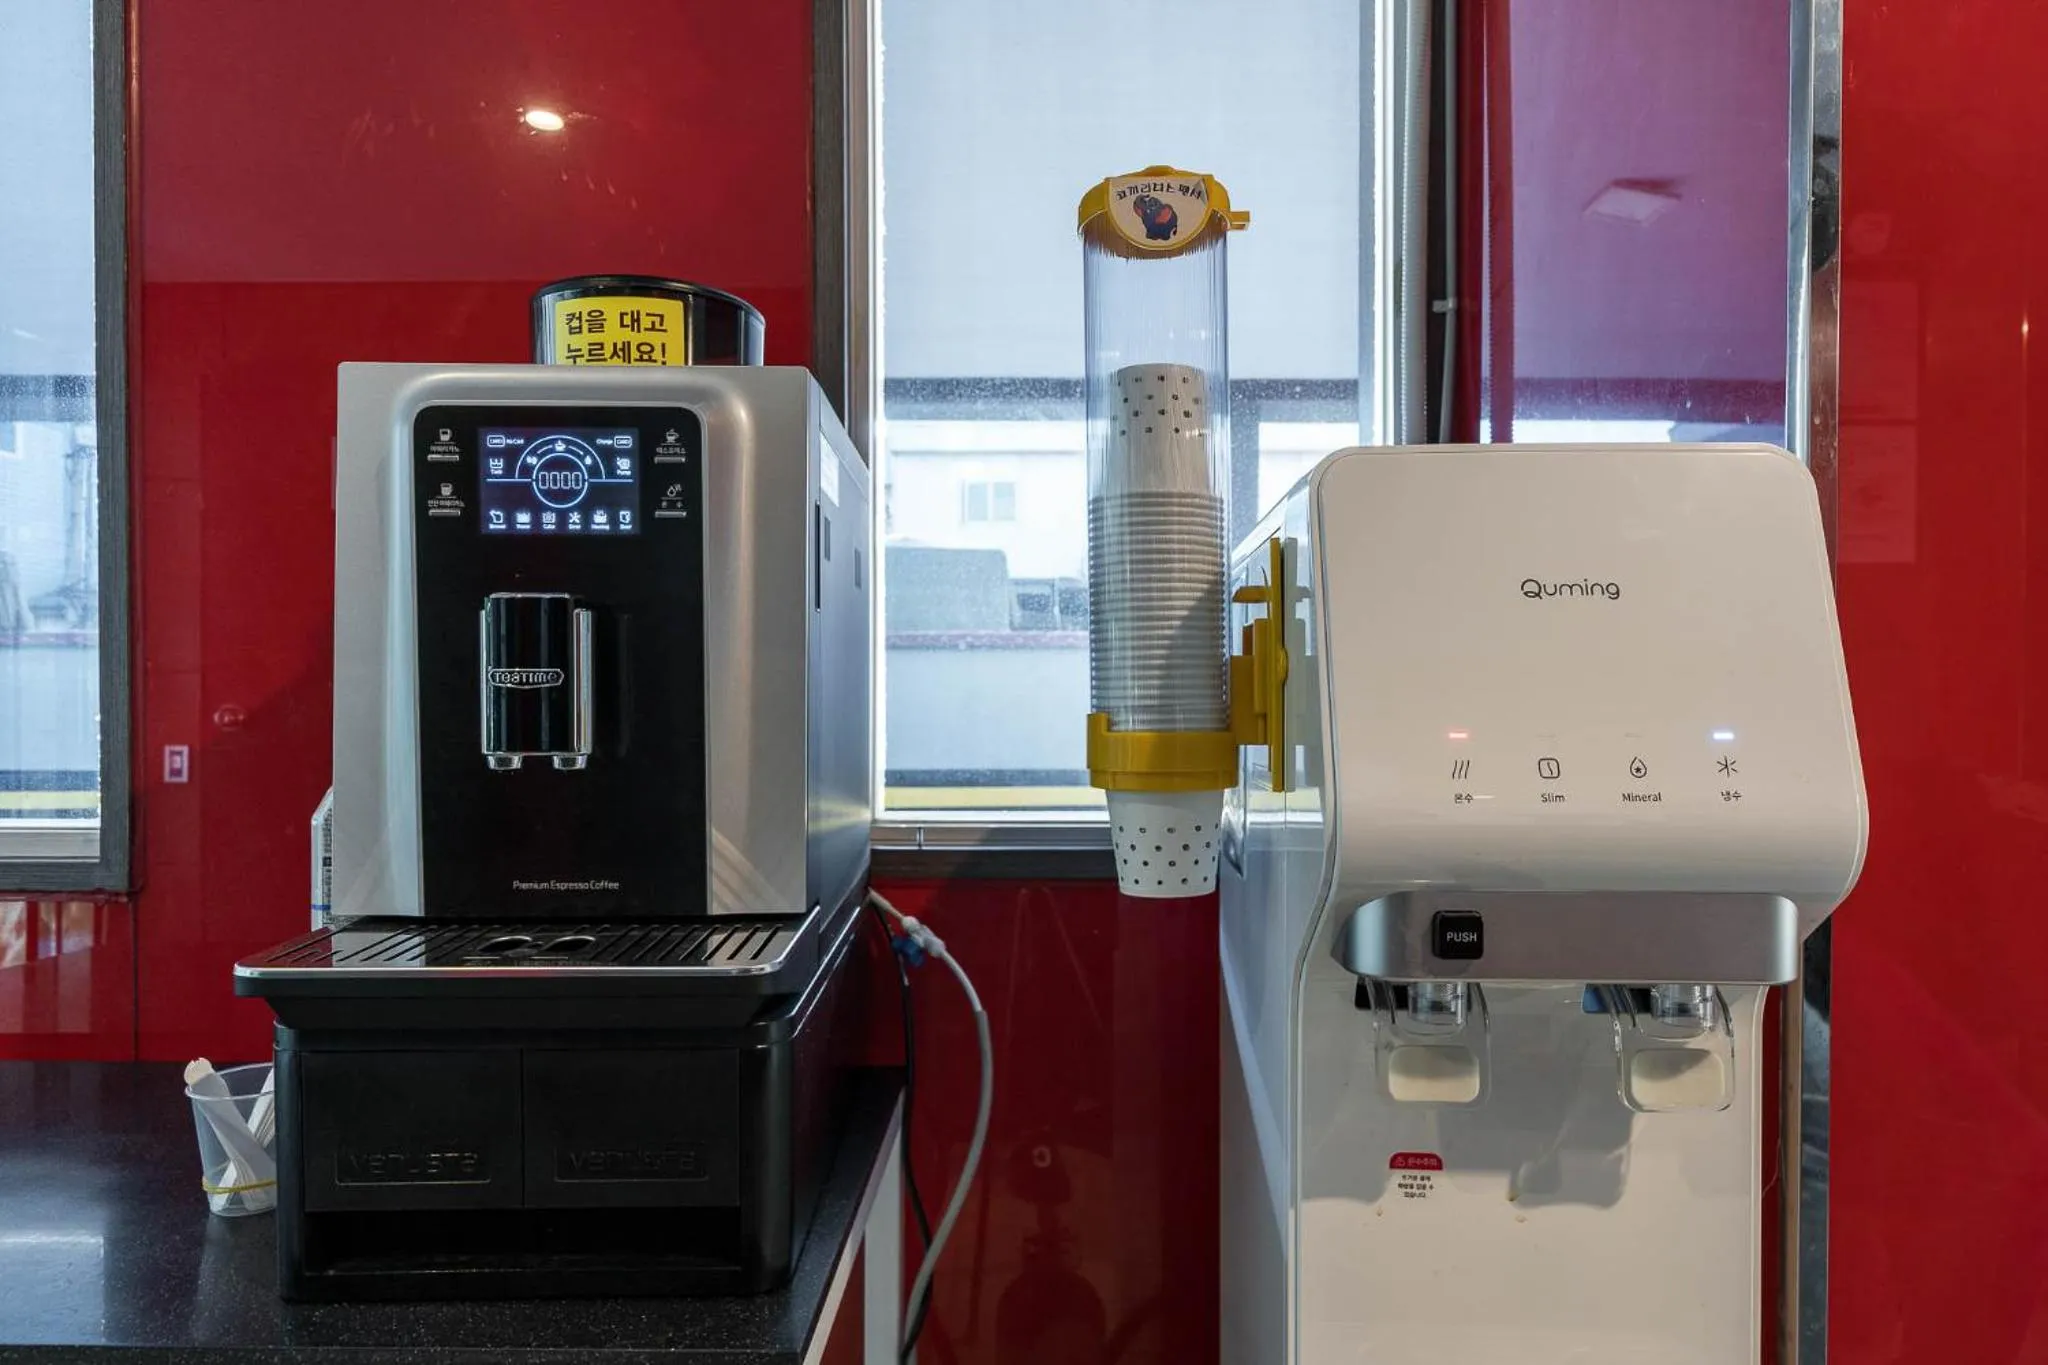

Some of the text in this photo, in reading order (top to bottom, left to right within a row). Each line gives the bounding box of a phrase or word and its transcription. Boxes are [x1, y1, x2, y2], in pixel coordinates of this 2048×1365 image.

[565, 309, 668, 335] 컵을 대고
[565, 341, 668, 365] 누르세요!
[1521, 579, 1620, 600] Quming
[1454, 793, 1474, 804] 온수
[1541, 792, 1566, 803] Slim
[1622, 792, 1663, 802] Mineral
[1721, 790, 1742, 802] 냉수
[512, 880, 620, 891] Premium Espresso Coffee
[1446, 931, 1477, 943] PUSH
